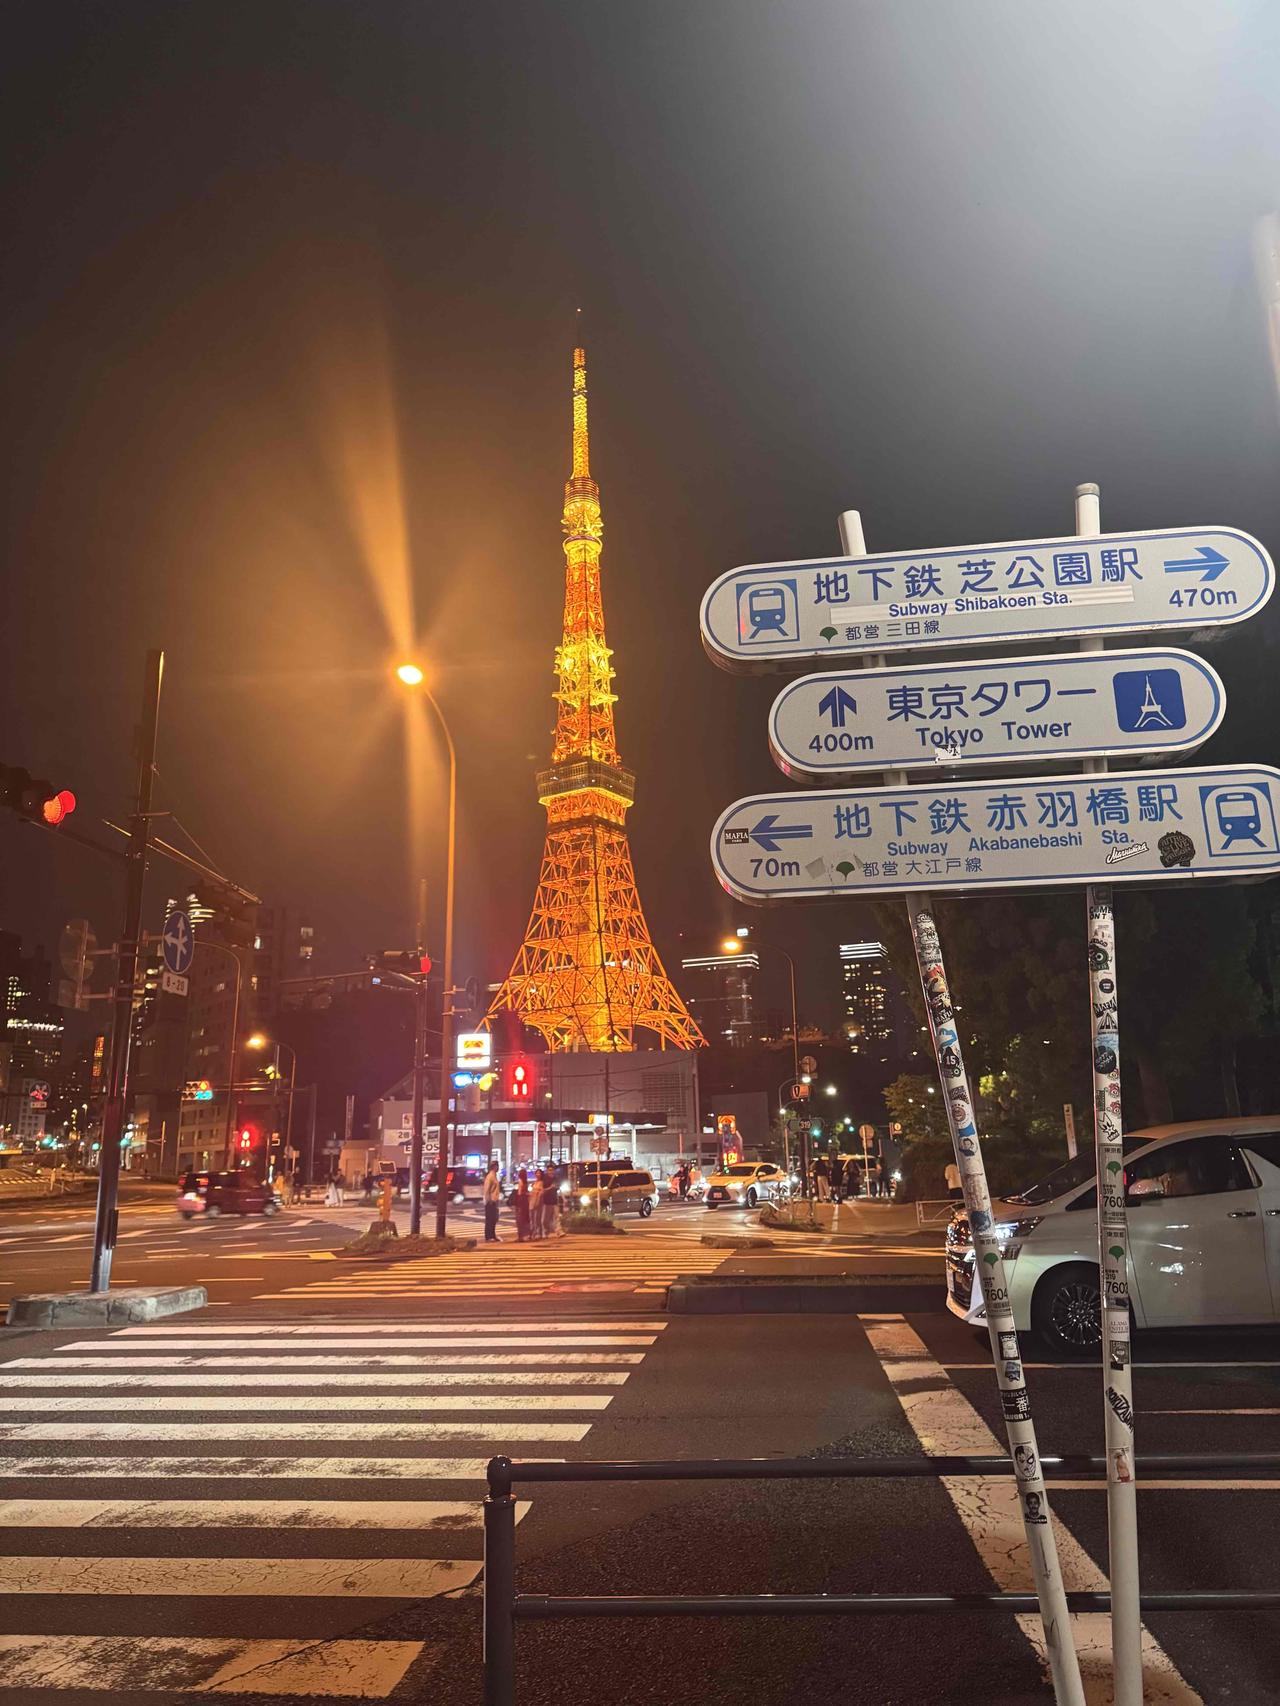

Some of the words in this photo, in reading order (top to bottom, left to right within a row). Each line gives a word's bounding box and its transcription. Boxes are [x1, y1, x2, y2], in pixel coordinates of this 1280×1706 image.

[813, 563, 944, 604] 地下鉄
[957, 547, 1143, 595] 芝公園駅
[889, 602, 948, 617] Subway
[955, 594, 1037, 612] Shibakoen
[1042, 590, 1073, 605] Sta.
[1168, 587, 1238, 608] 470m
[886, 620, 941, 637] 三田線
[886, 679, 1097, 722] 東京タワー
[808, 732, 874, 753] 400m
[915, 726, 984, 748] Tokyo
[1001, 720, 1072, 741] Tower
[833, 798, 972, 840] 地下鉄
[985, 784, 1184, 832] 赤羽橋駅
[725, 832, 748, 840] MAFIA
[887, 841, 948, 857] Subway
[968, 831, 1083, 851] Akabanebashi
[1101, 829, 1134, 845] Sta.
[750, 858, 801, 878] 70m
[905, 857, 983, 876] 大江戸線
[945, 1055, 956, 1065] 15
[405, 1143, 440, 1152] EEOS
[984, 1287, 1009, 1301] 7604
